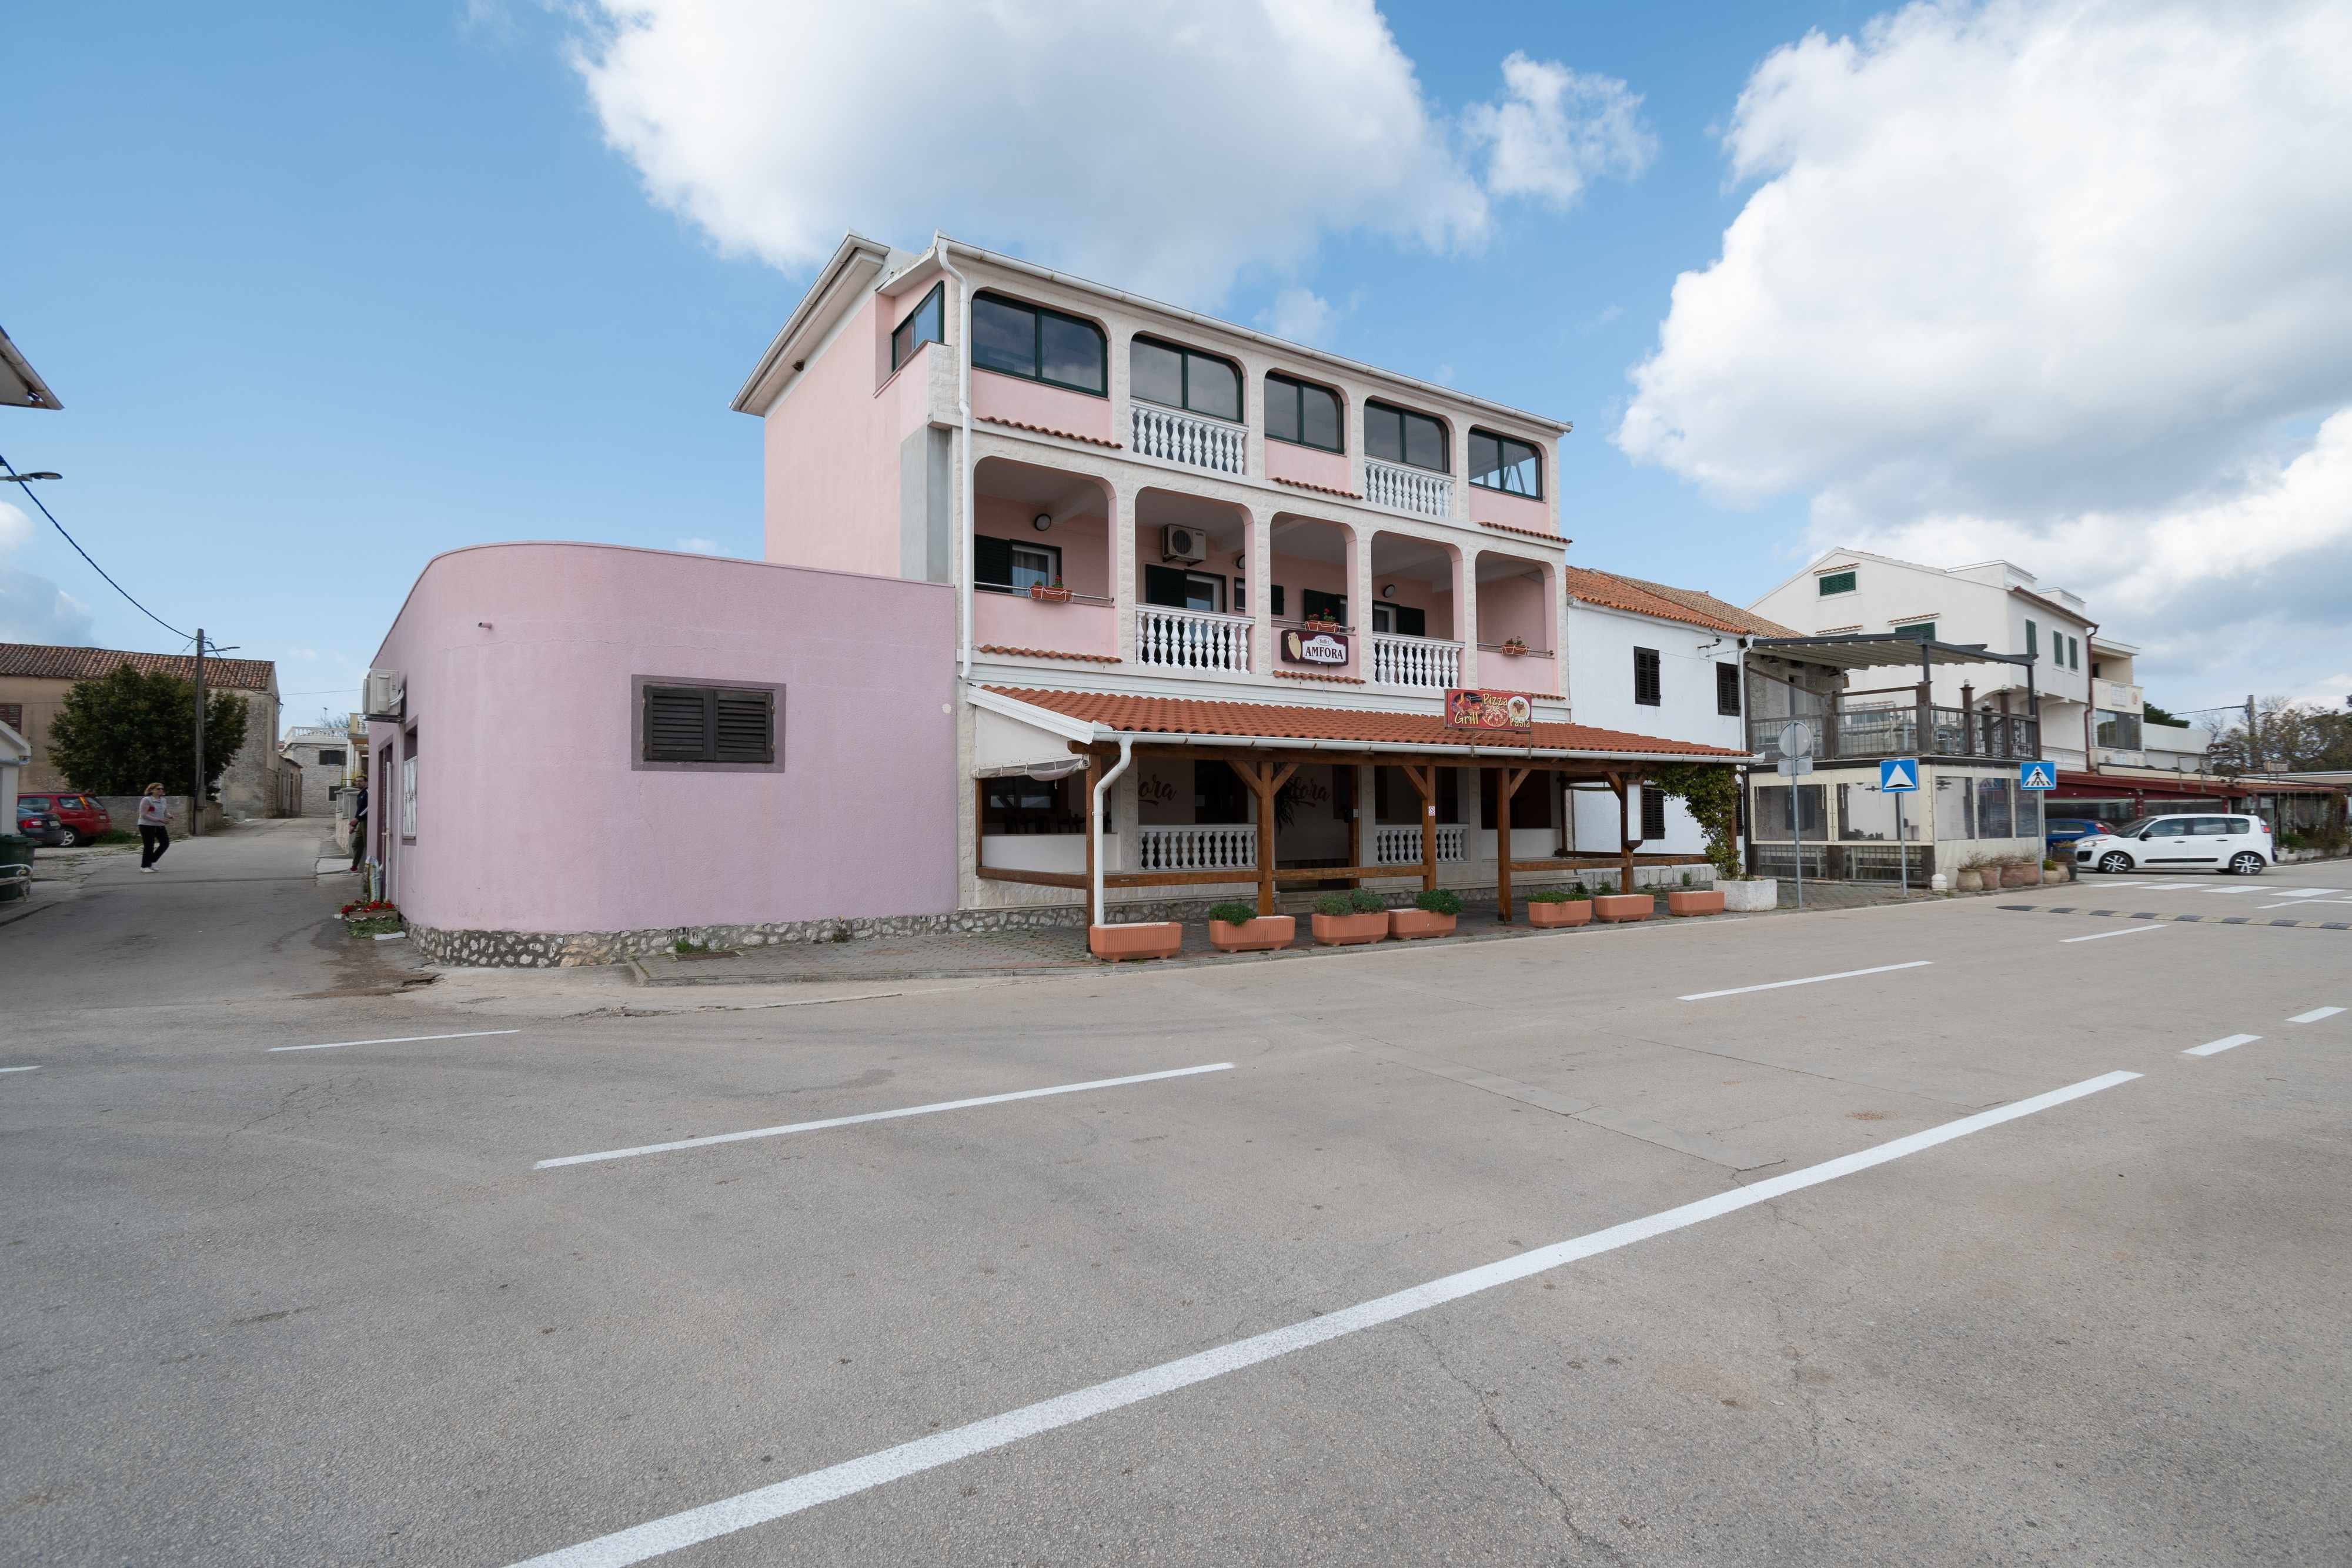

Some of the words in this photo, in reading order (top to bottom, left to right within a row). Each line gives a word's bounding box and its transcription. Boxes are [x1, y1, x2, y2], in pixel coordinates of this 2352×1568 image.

[1305, 646, 1344, 660] AMFORA
[1482, 693, 1508, 706] Pizza
[1454, 711, 1479, 725] Grill
[1509, 715, 1530, 728] Pasta
